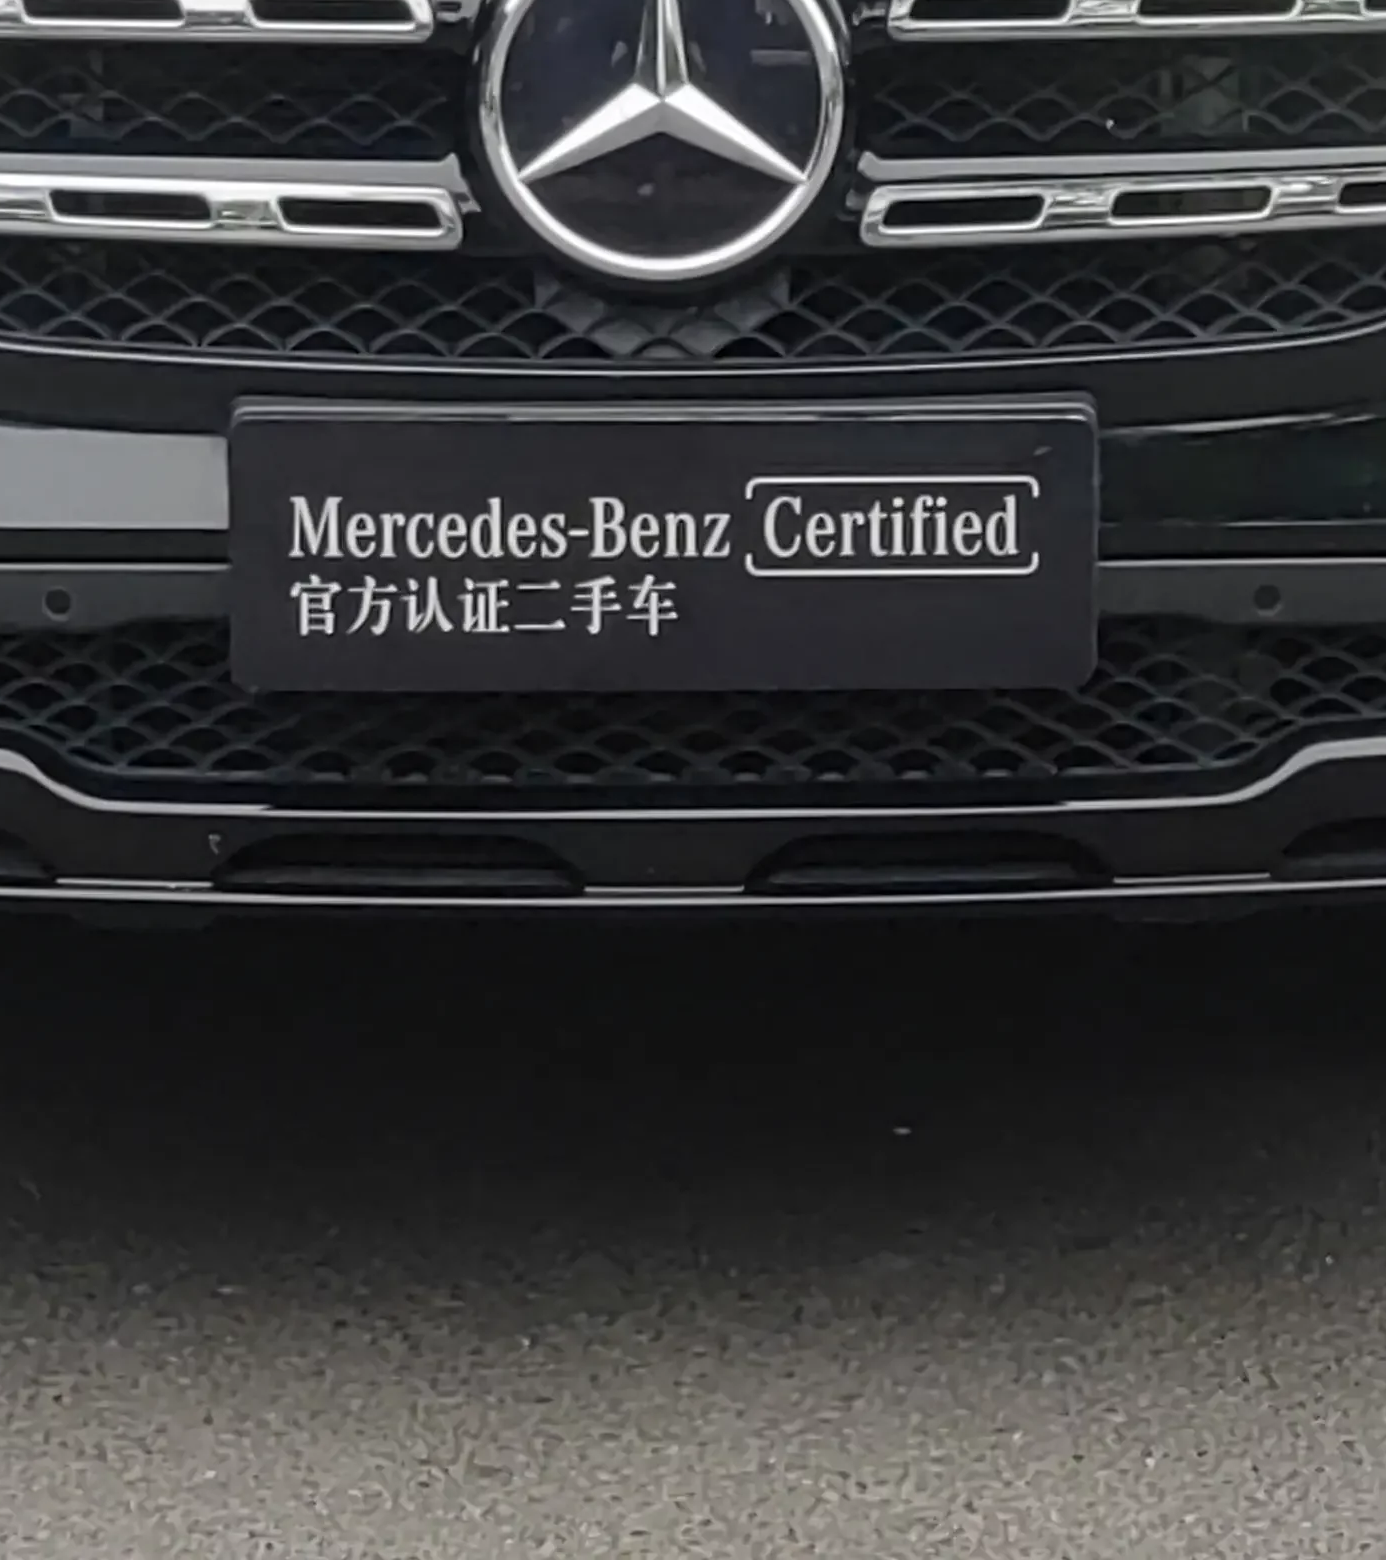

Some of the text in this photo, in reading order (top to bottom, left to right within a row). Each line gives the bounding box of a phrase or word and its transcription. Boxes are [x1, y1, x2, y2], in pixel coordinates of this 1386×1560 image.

[288, 494, 1019, 558] Mercedes-Benz Certified
[289, 573, 680, 636] 官方认证二手车
